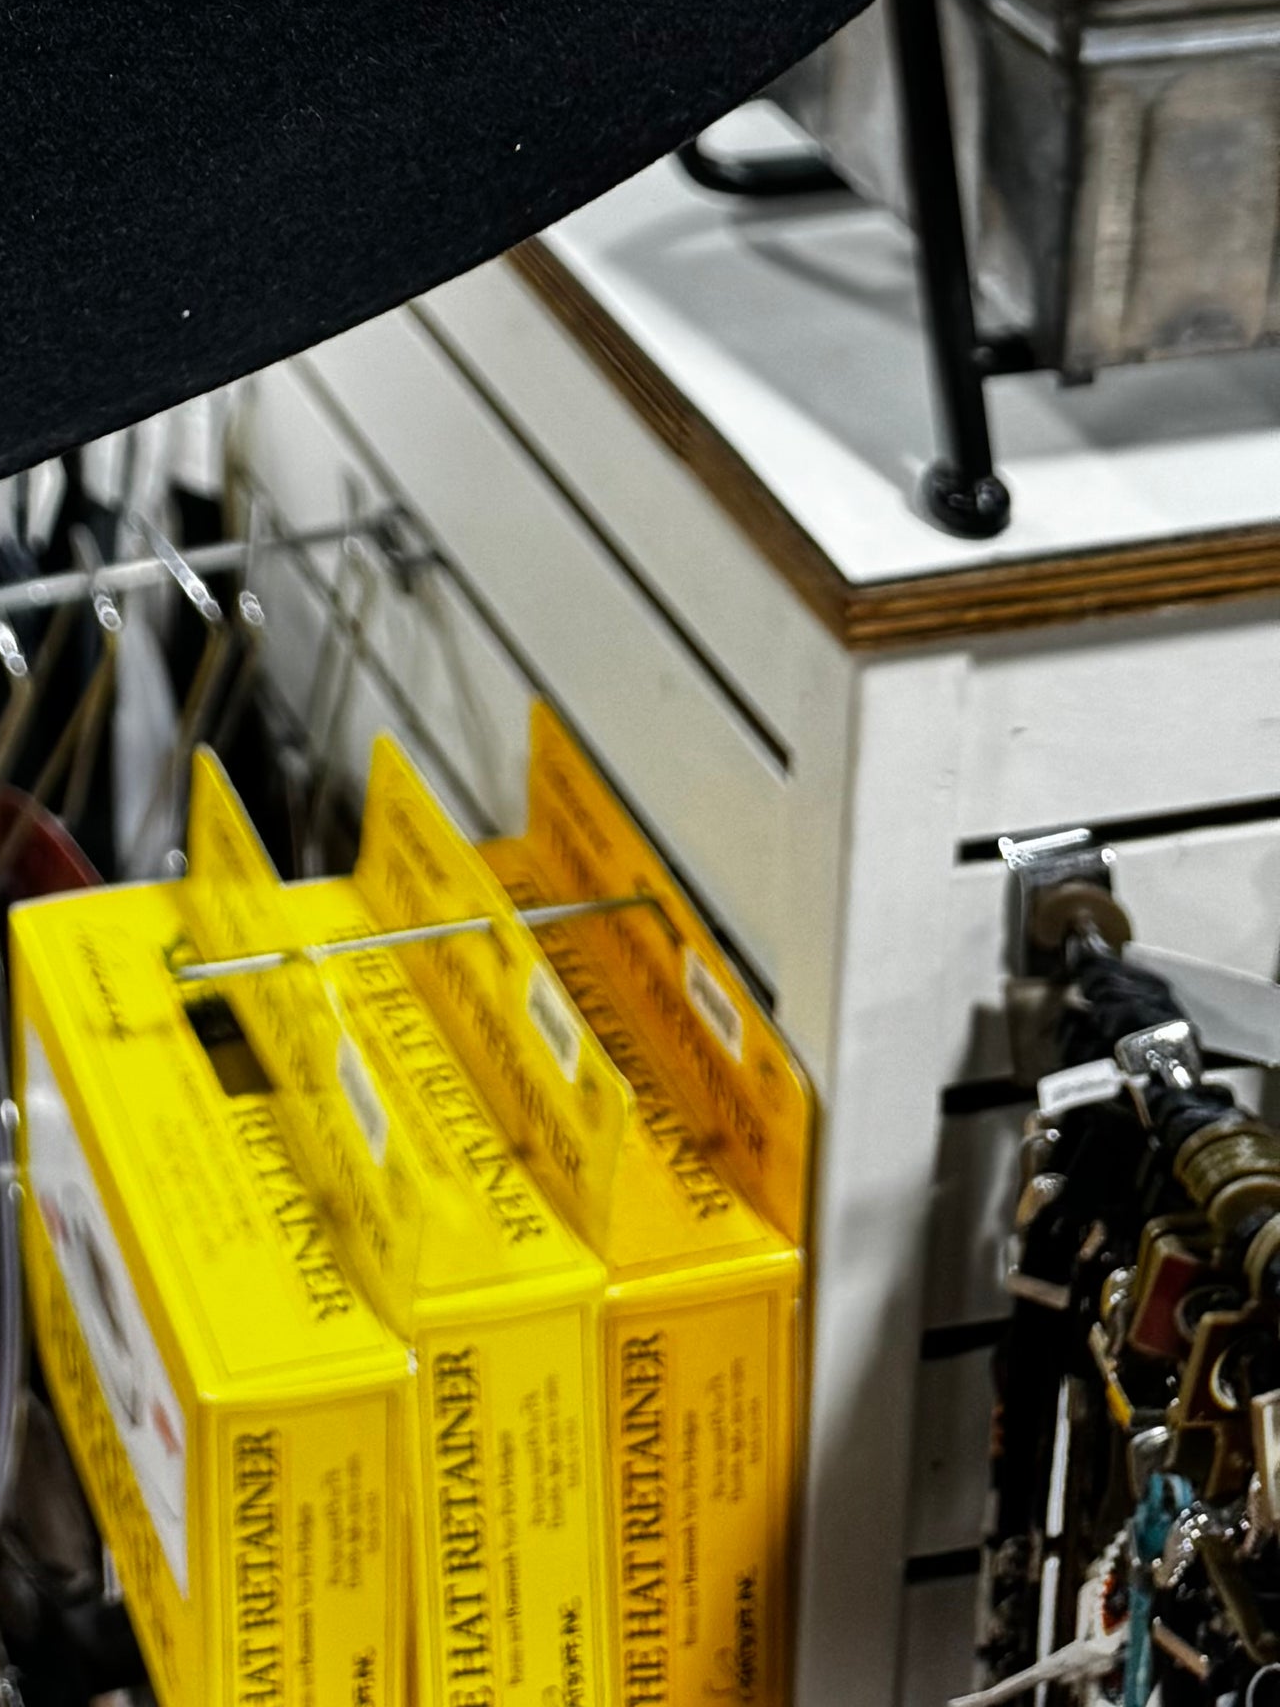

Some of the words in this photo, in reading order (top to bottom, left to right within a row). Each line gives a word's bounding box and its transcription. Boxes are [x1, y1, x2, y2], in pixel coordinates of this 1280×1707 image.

[227, 1094, 355, 1323] RETAINER
[368, 986, 440, 1062] HAT
[412, 1061, 546, 1247] RETAINER
[233, 1427, 282, 1633] RETAINER
[433, 1344, 486, 1577] RETAINER
[621, 1330, 667, 1546] RETAINER
[444, 1582, 491, 1683] HAT
[622, 1550, 668, 1643] HAT
